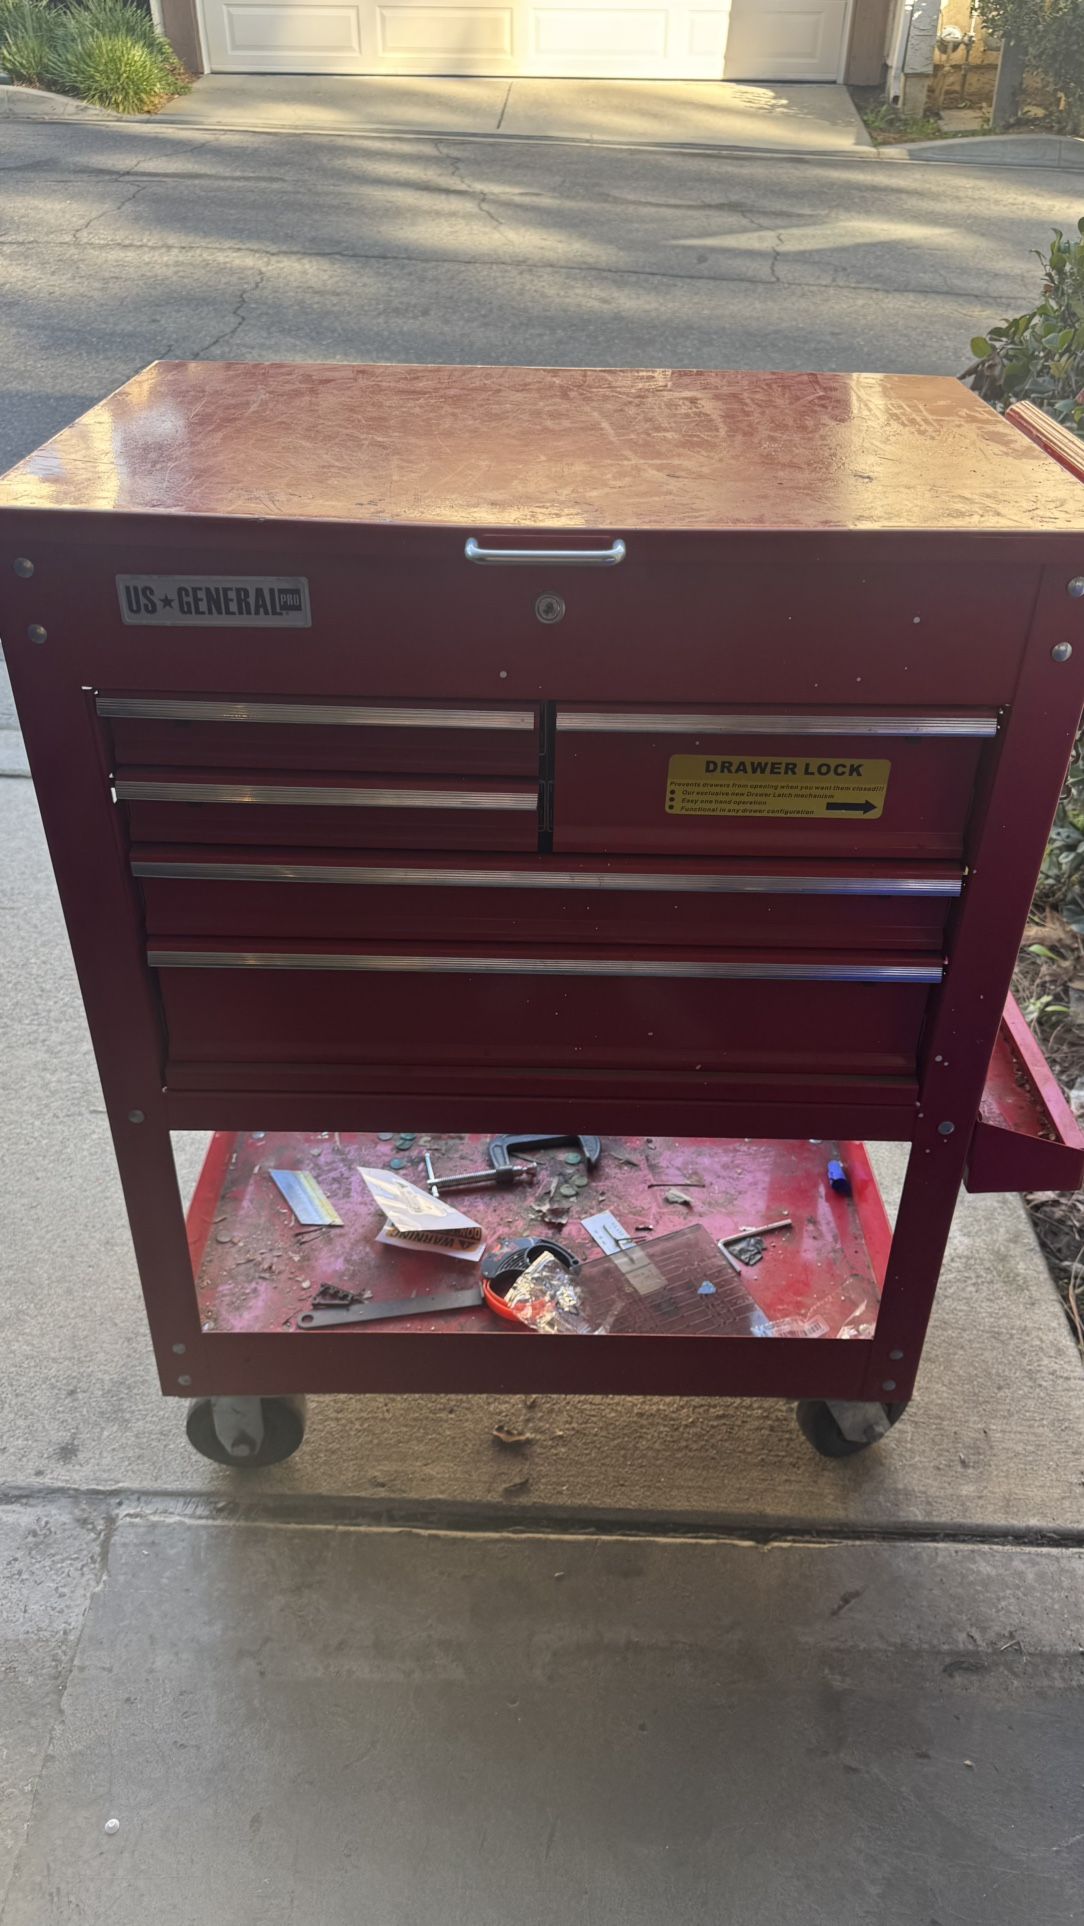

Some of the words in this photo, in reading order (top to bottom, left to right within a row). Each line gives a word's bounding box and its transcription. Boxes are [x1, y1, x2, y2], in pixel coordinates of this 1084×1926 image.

[124, 585, 158, 615] US
[176, 586, 283, 616] GENERAL
[280, 593, 300, 607] PRO
[705, 760, 797, 775] DRAWER
[803, 762, 864, 777] LOCK
[681, 797, 699, 805] Easy
[696, 789, 729, 797] exclusive
[389, 1229, 455, 1248] WARNING
